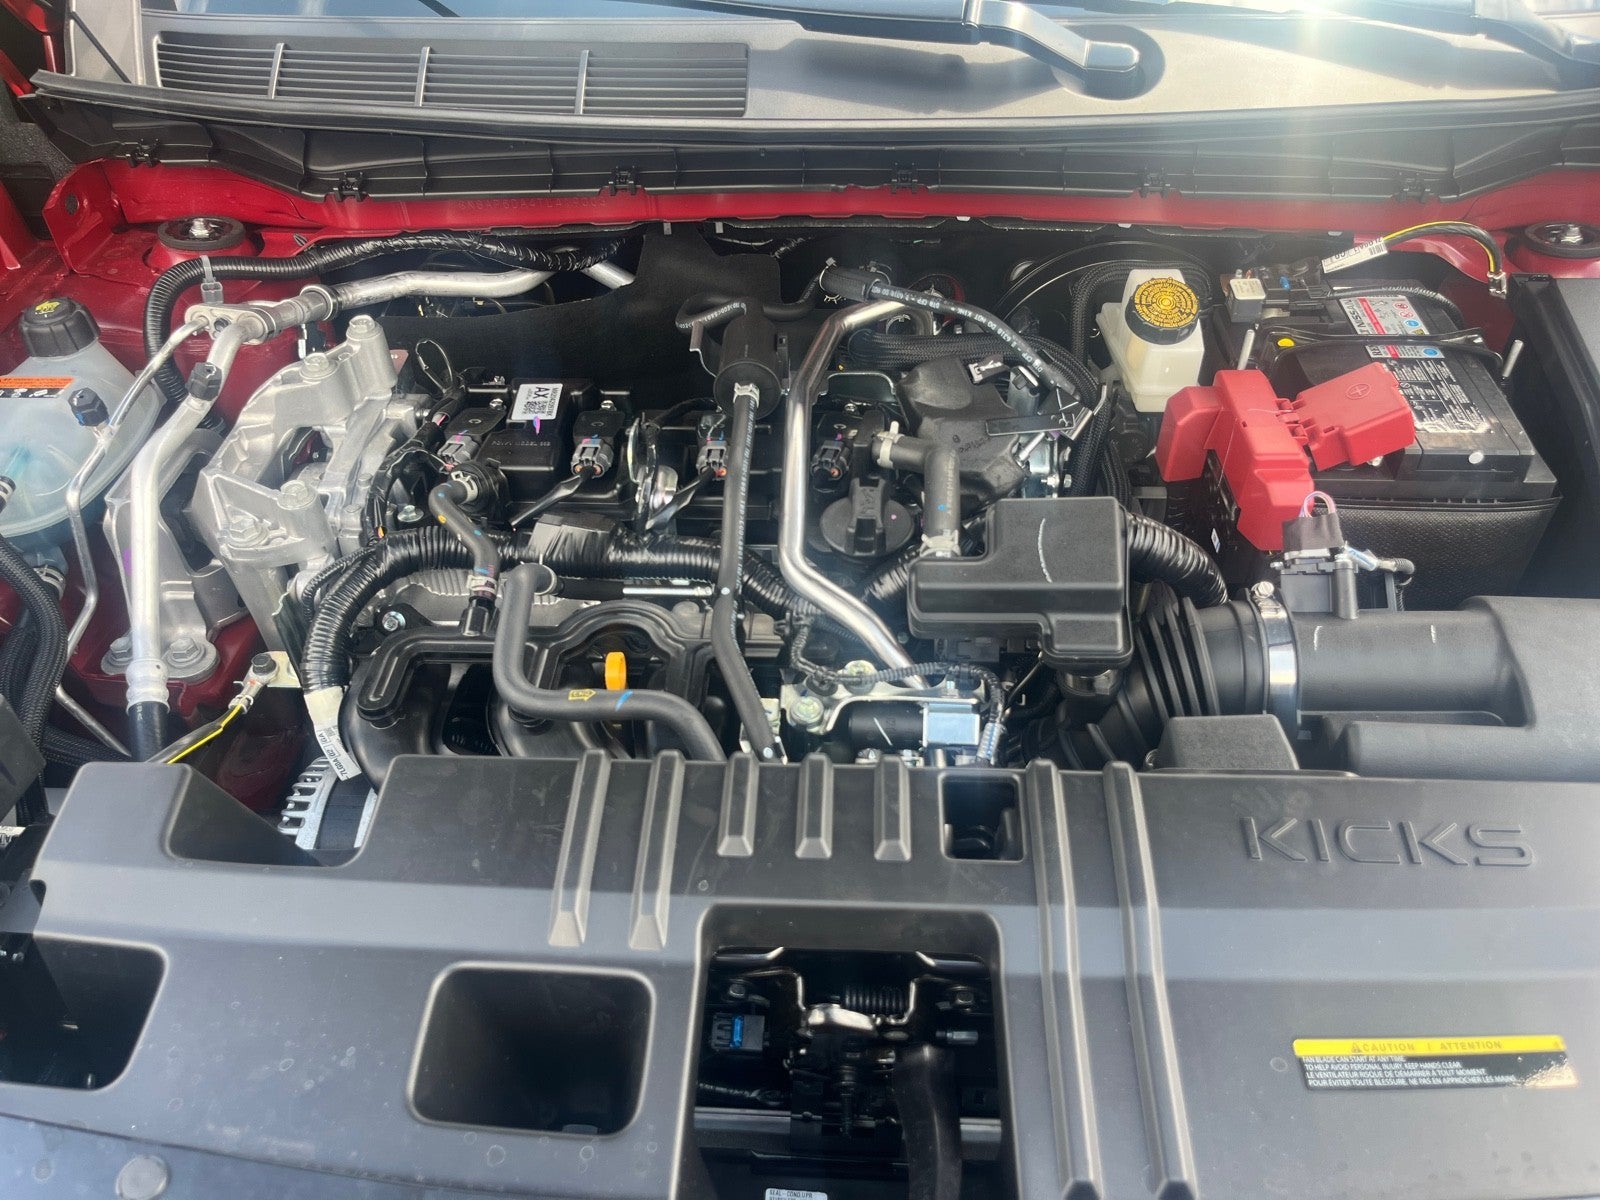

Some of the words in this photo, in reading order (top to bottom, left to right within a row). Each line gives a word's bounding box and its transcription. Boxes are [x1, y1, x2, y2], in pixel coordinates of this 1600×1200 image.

[532, 386, 550, 400] AX
[1241, 816, 1537, 867] KICKS
[1362, 1042, 1415, 1053] CAUTION
[1439, 1040, 1503, 1051] ATTENTION
[1304, 1063, 1314, 1071] TO
[1314, 1063, 1330, 1071] HELP
[1330, 1063, 1350, 1071] AVOID
[1305, 1071, 1315, 1079] LE
[1315, 1071, 1359, 1079] VENTILATEUR
[1308, 1079, 1329, 1087] POUR
